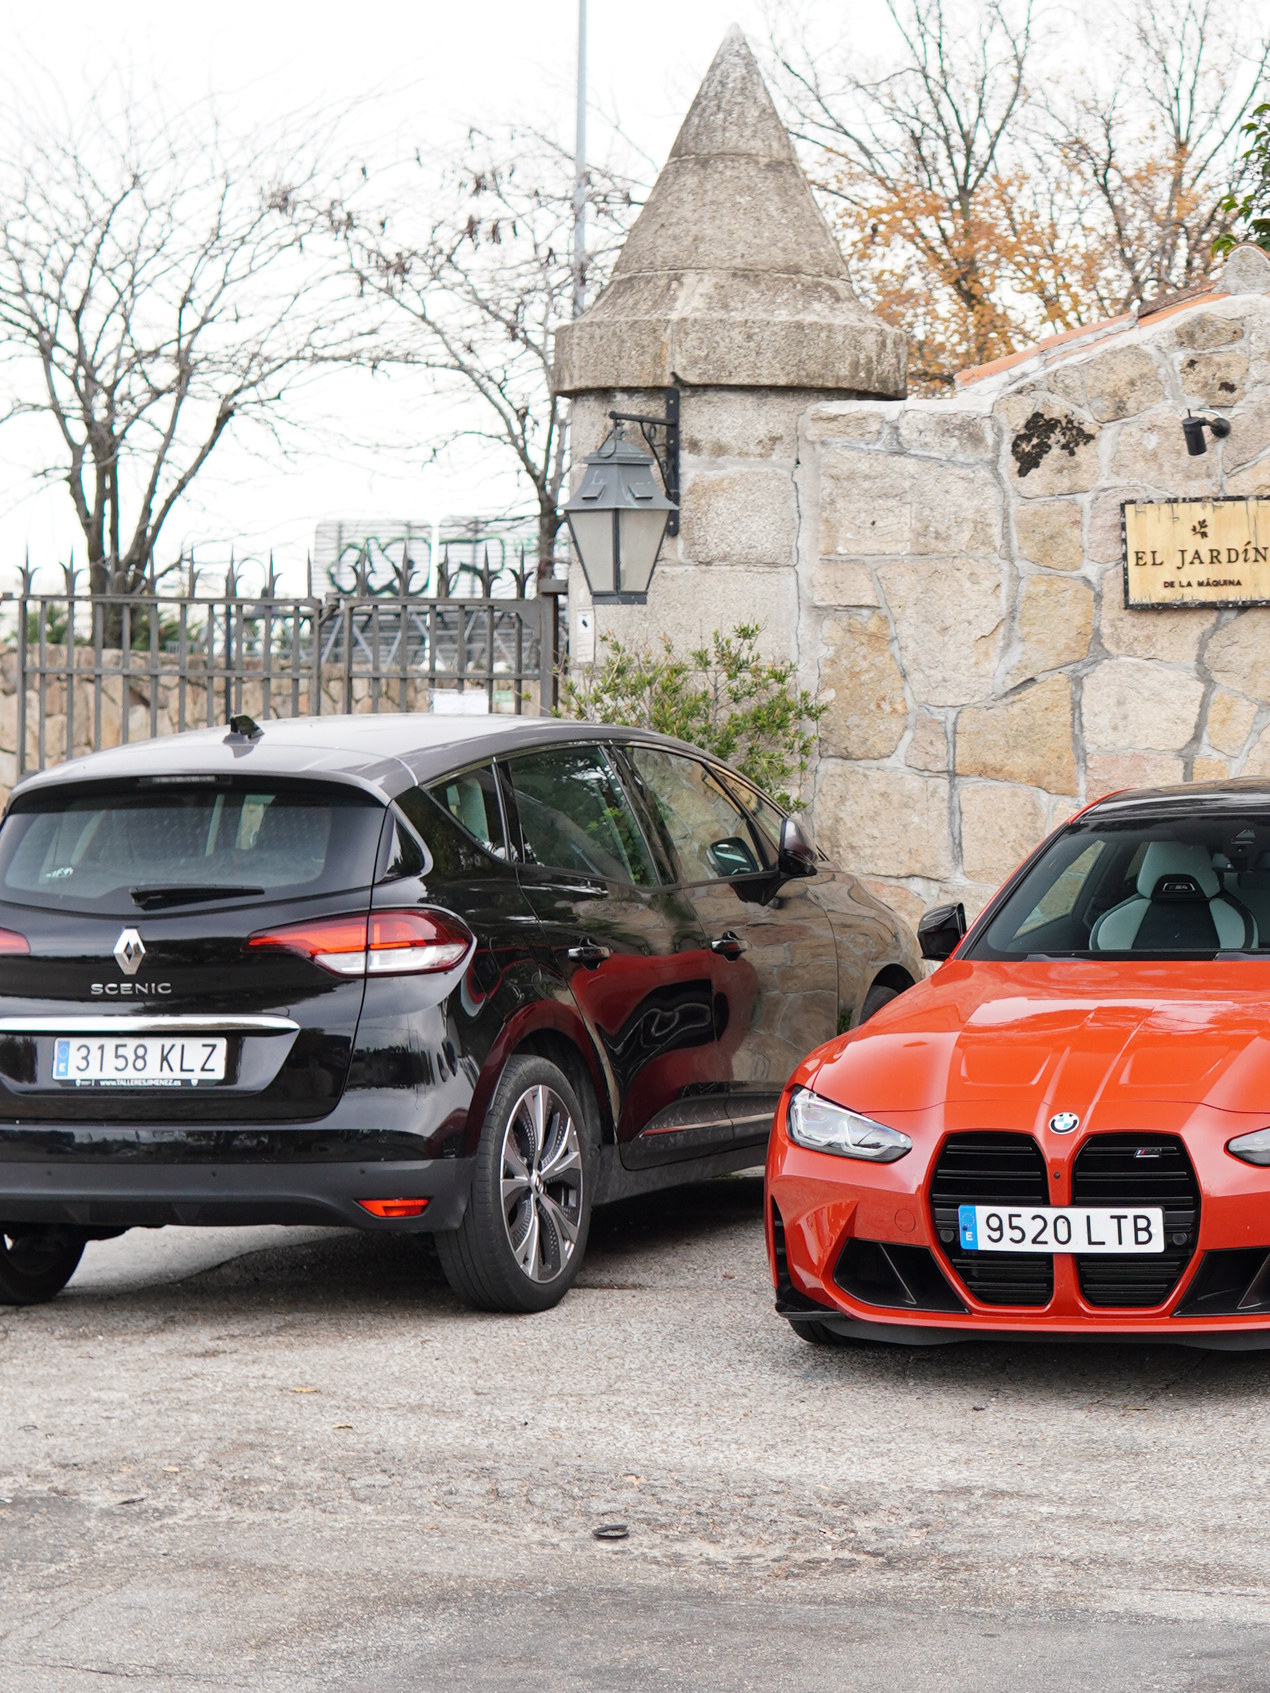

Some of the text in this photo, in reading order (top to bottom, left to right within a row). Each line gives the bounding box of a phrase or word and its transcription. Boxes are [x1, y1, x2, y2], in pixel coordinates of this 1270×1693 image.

[1134, 550, 1164, 567] EL
[1163, 580, 1175, 588] DE
[1179, 580, 1192, 588] LA
[91, 983, 172, 995] SCENIC
[76, 1044, 148, 1072] 3158
[160, 1043, 217, 1073] KLZ
[965, 1213, 1153, 1246] E 9520 LTB
